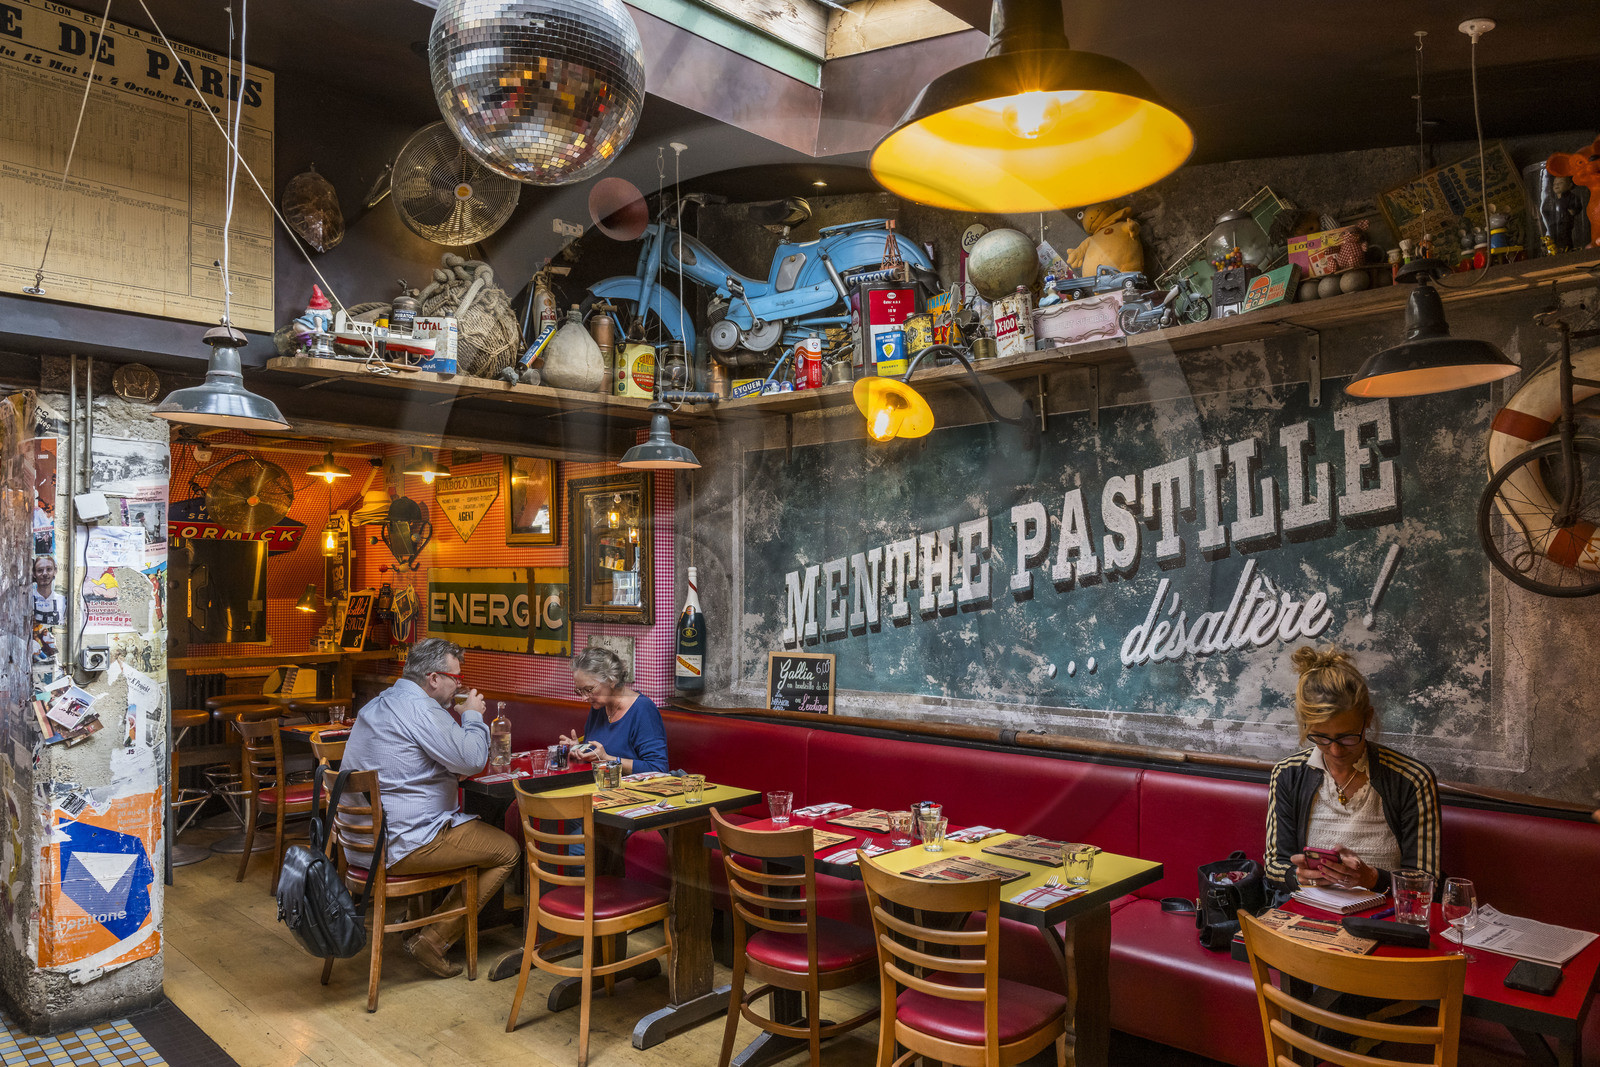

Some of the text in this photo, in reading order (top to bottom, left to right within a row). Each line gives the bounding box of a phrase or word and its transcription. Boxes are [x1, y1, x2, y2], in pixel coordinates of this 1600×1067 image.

[44, 2, 71, 16] LYON
[83, 14, 96, 23] ET
[127, 28, 140, 38] LA
[49, 59, 78, 74] Mai
[124, 81, 179, 102] Octobre
[59, 22, 115, 66] DE
[147, 48, 262, 108] PARIS
[1294, 242, 1314, 251] LOTO
[417, 321, 442, 330] TOTAL
[998, 317, 1015, 333] X-100
[458, 511, 474, 521] AGENT
[783, 397, 1399, 643] MENTHE PASTILLE
[430, 592, 563, 629] ENERGIC
[1119, 558, 1335, 667] désaltère
[777, 659, 815, 690] Gallia
[47, 910, 127, 933] Scopitone
